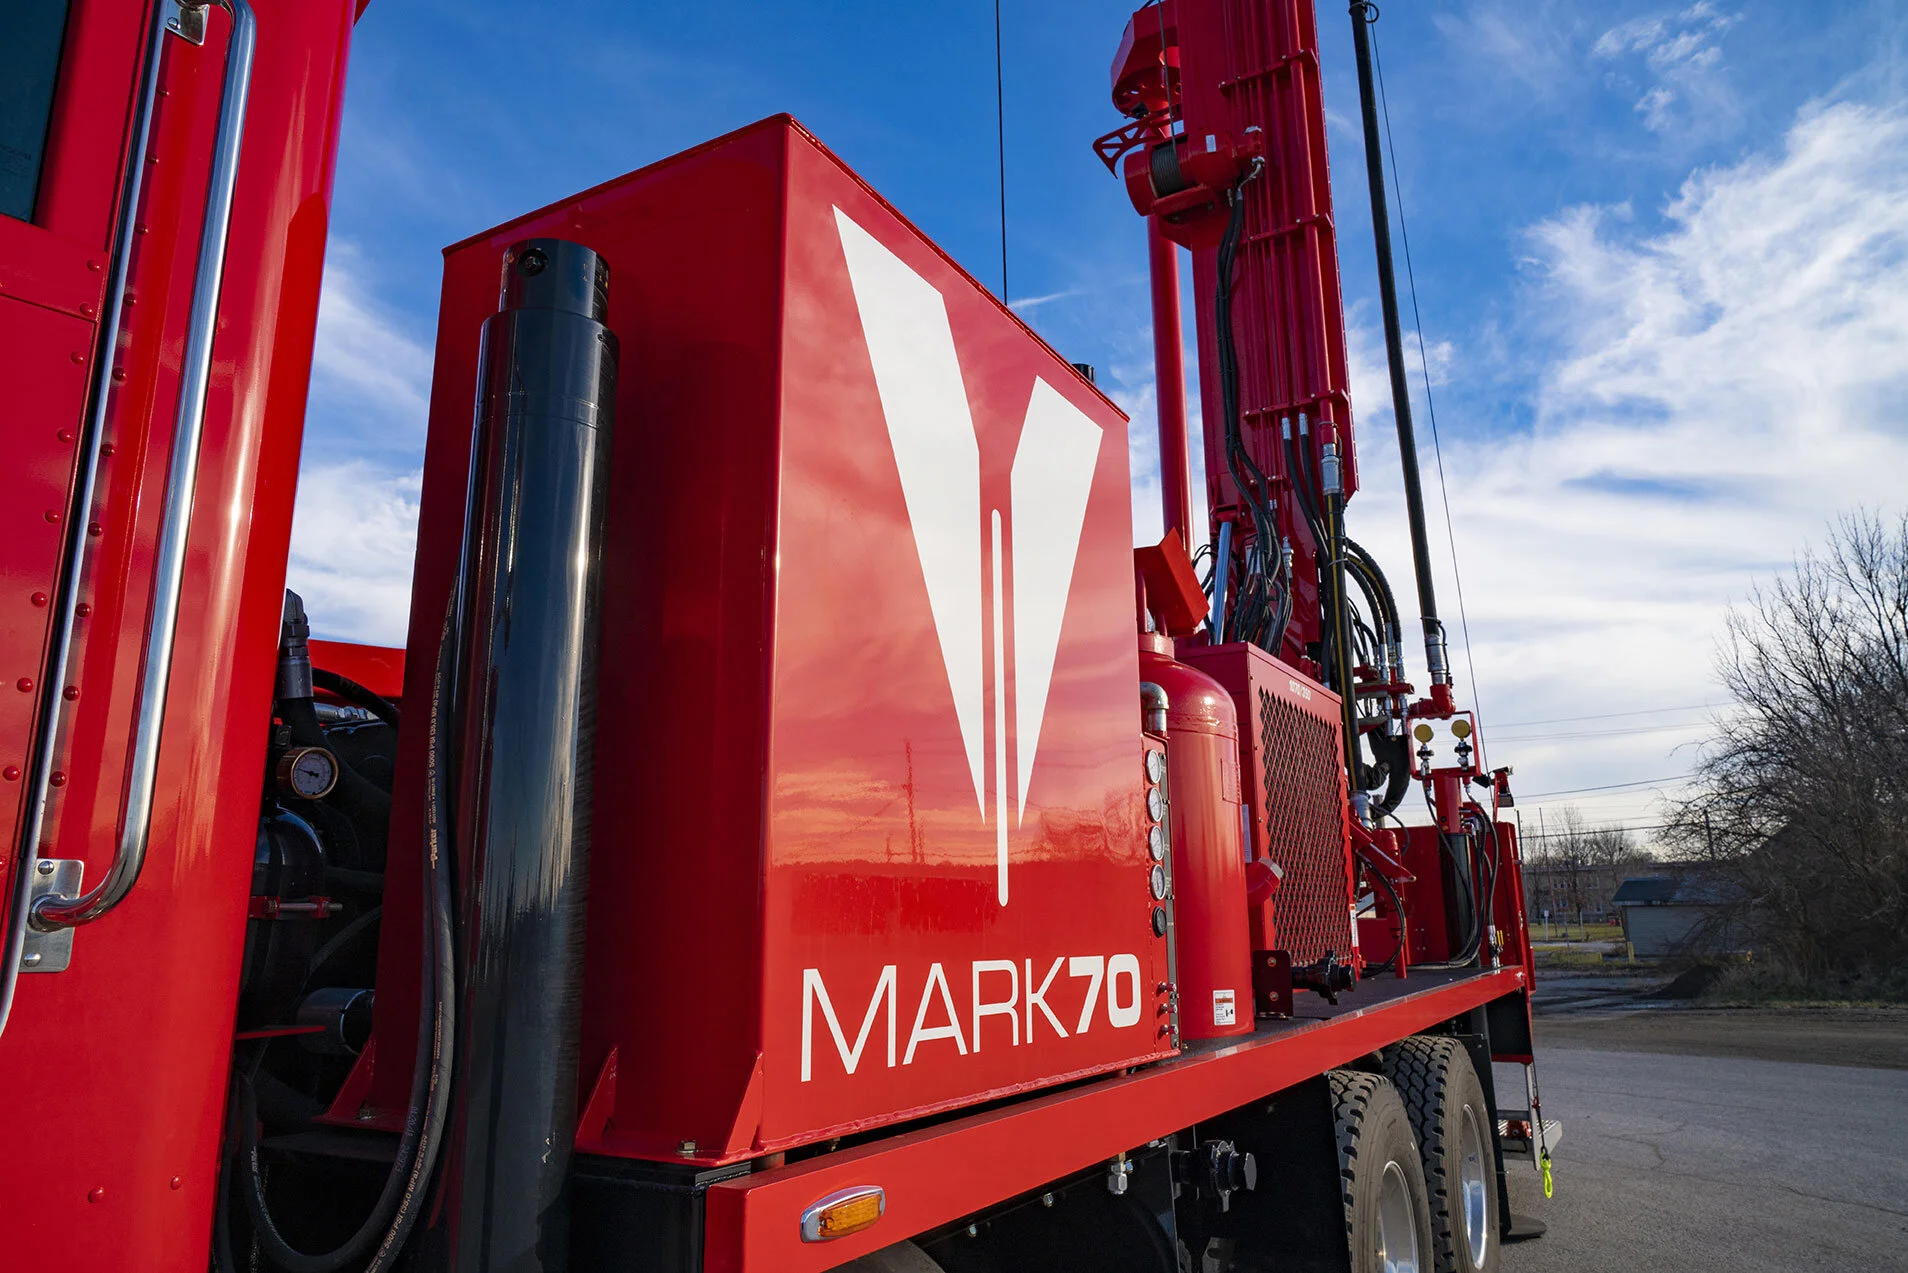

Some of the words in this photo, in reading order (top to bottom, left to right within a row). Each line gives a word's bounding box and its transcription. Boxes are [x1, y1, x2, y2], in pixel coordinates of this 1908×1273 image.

[428, 750, 436, 768] 5000
[429, 737, 437, 749] PSI
[430, 829, 438, 866] Parker
[801, 954, 1142, 1082] MARK70
[384, 1228, 397, 1249] 5000
[393, 1213, 404, 1229] PSI
[408, 1171, 420, 1193] MPa)
